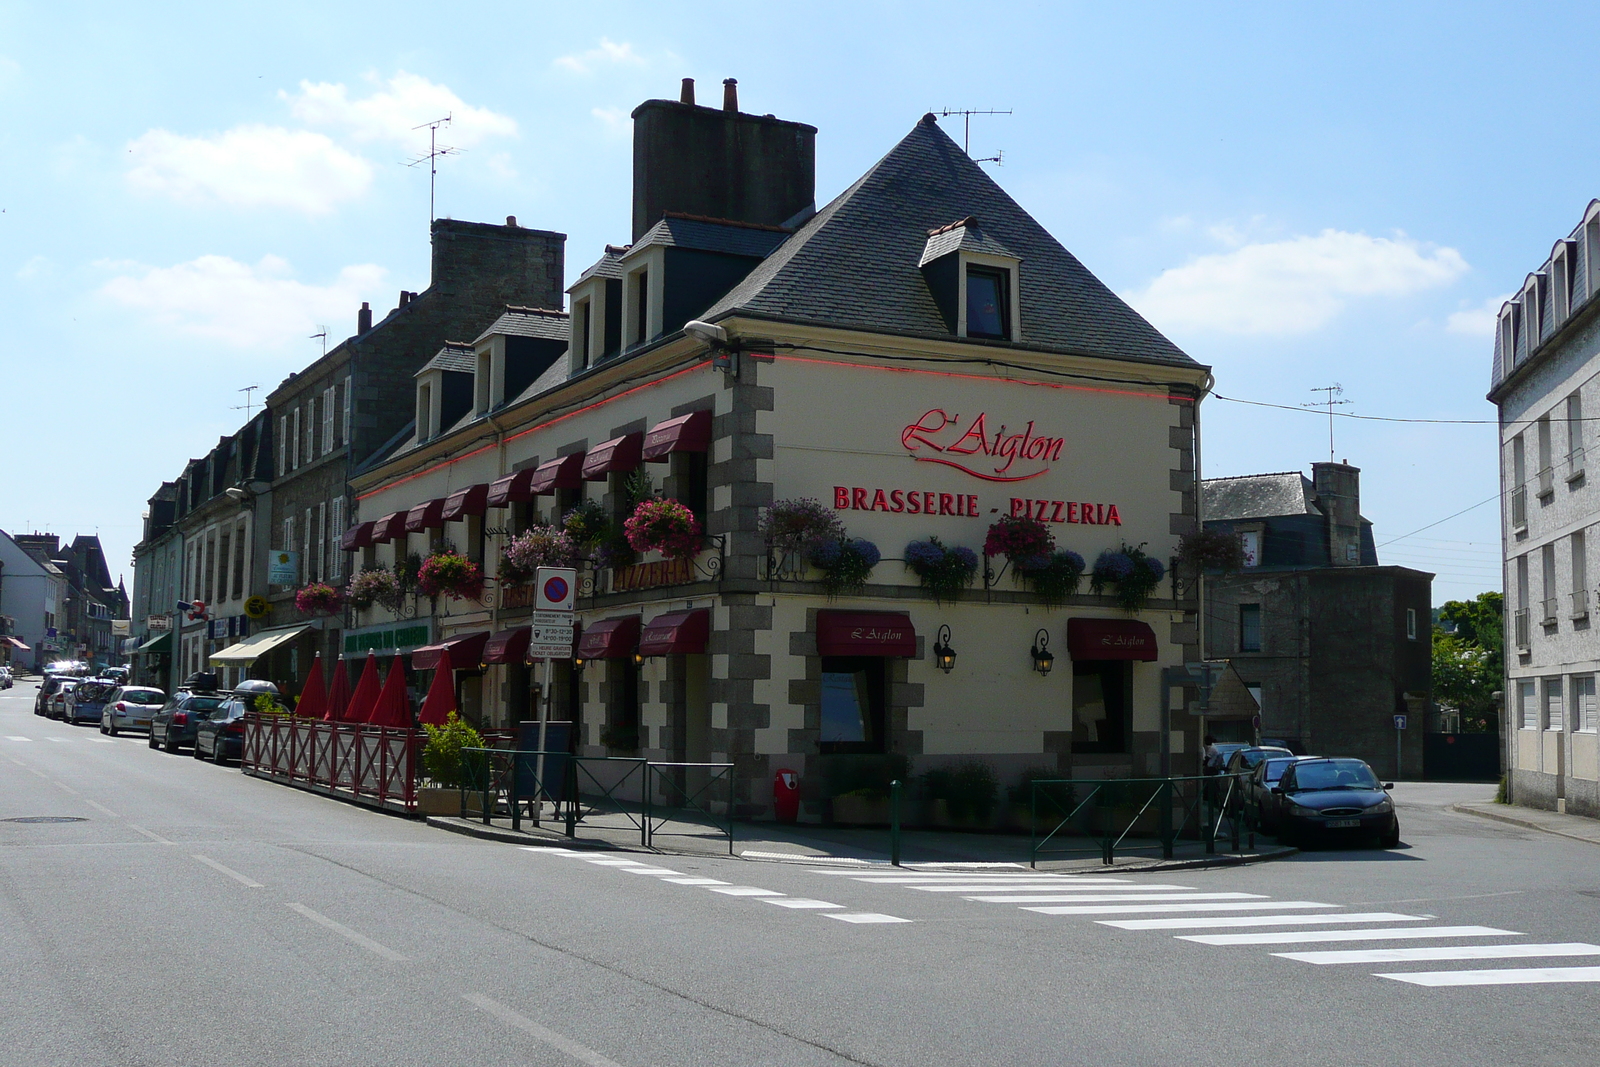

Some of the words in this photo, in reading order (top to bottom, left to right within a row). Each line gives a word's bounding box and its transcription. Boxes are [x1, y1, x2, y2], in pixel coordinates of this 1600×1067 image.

[901, 408, 1065, 472] L'Aiglon
[833, 486, 980, 517] BRASSERIE
[1009, 497, 1122, 526] PIZZERIA
[612, 557, 692, 592] PIZZERIA
